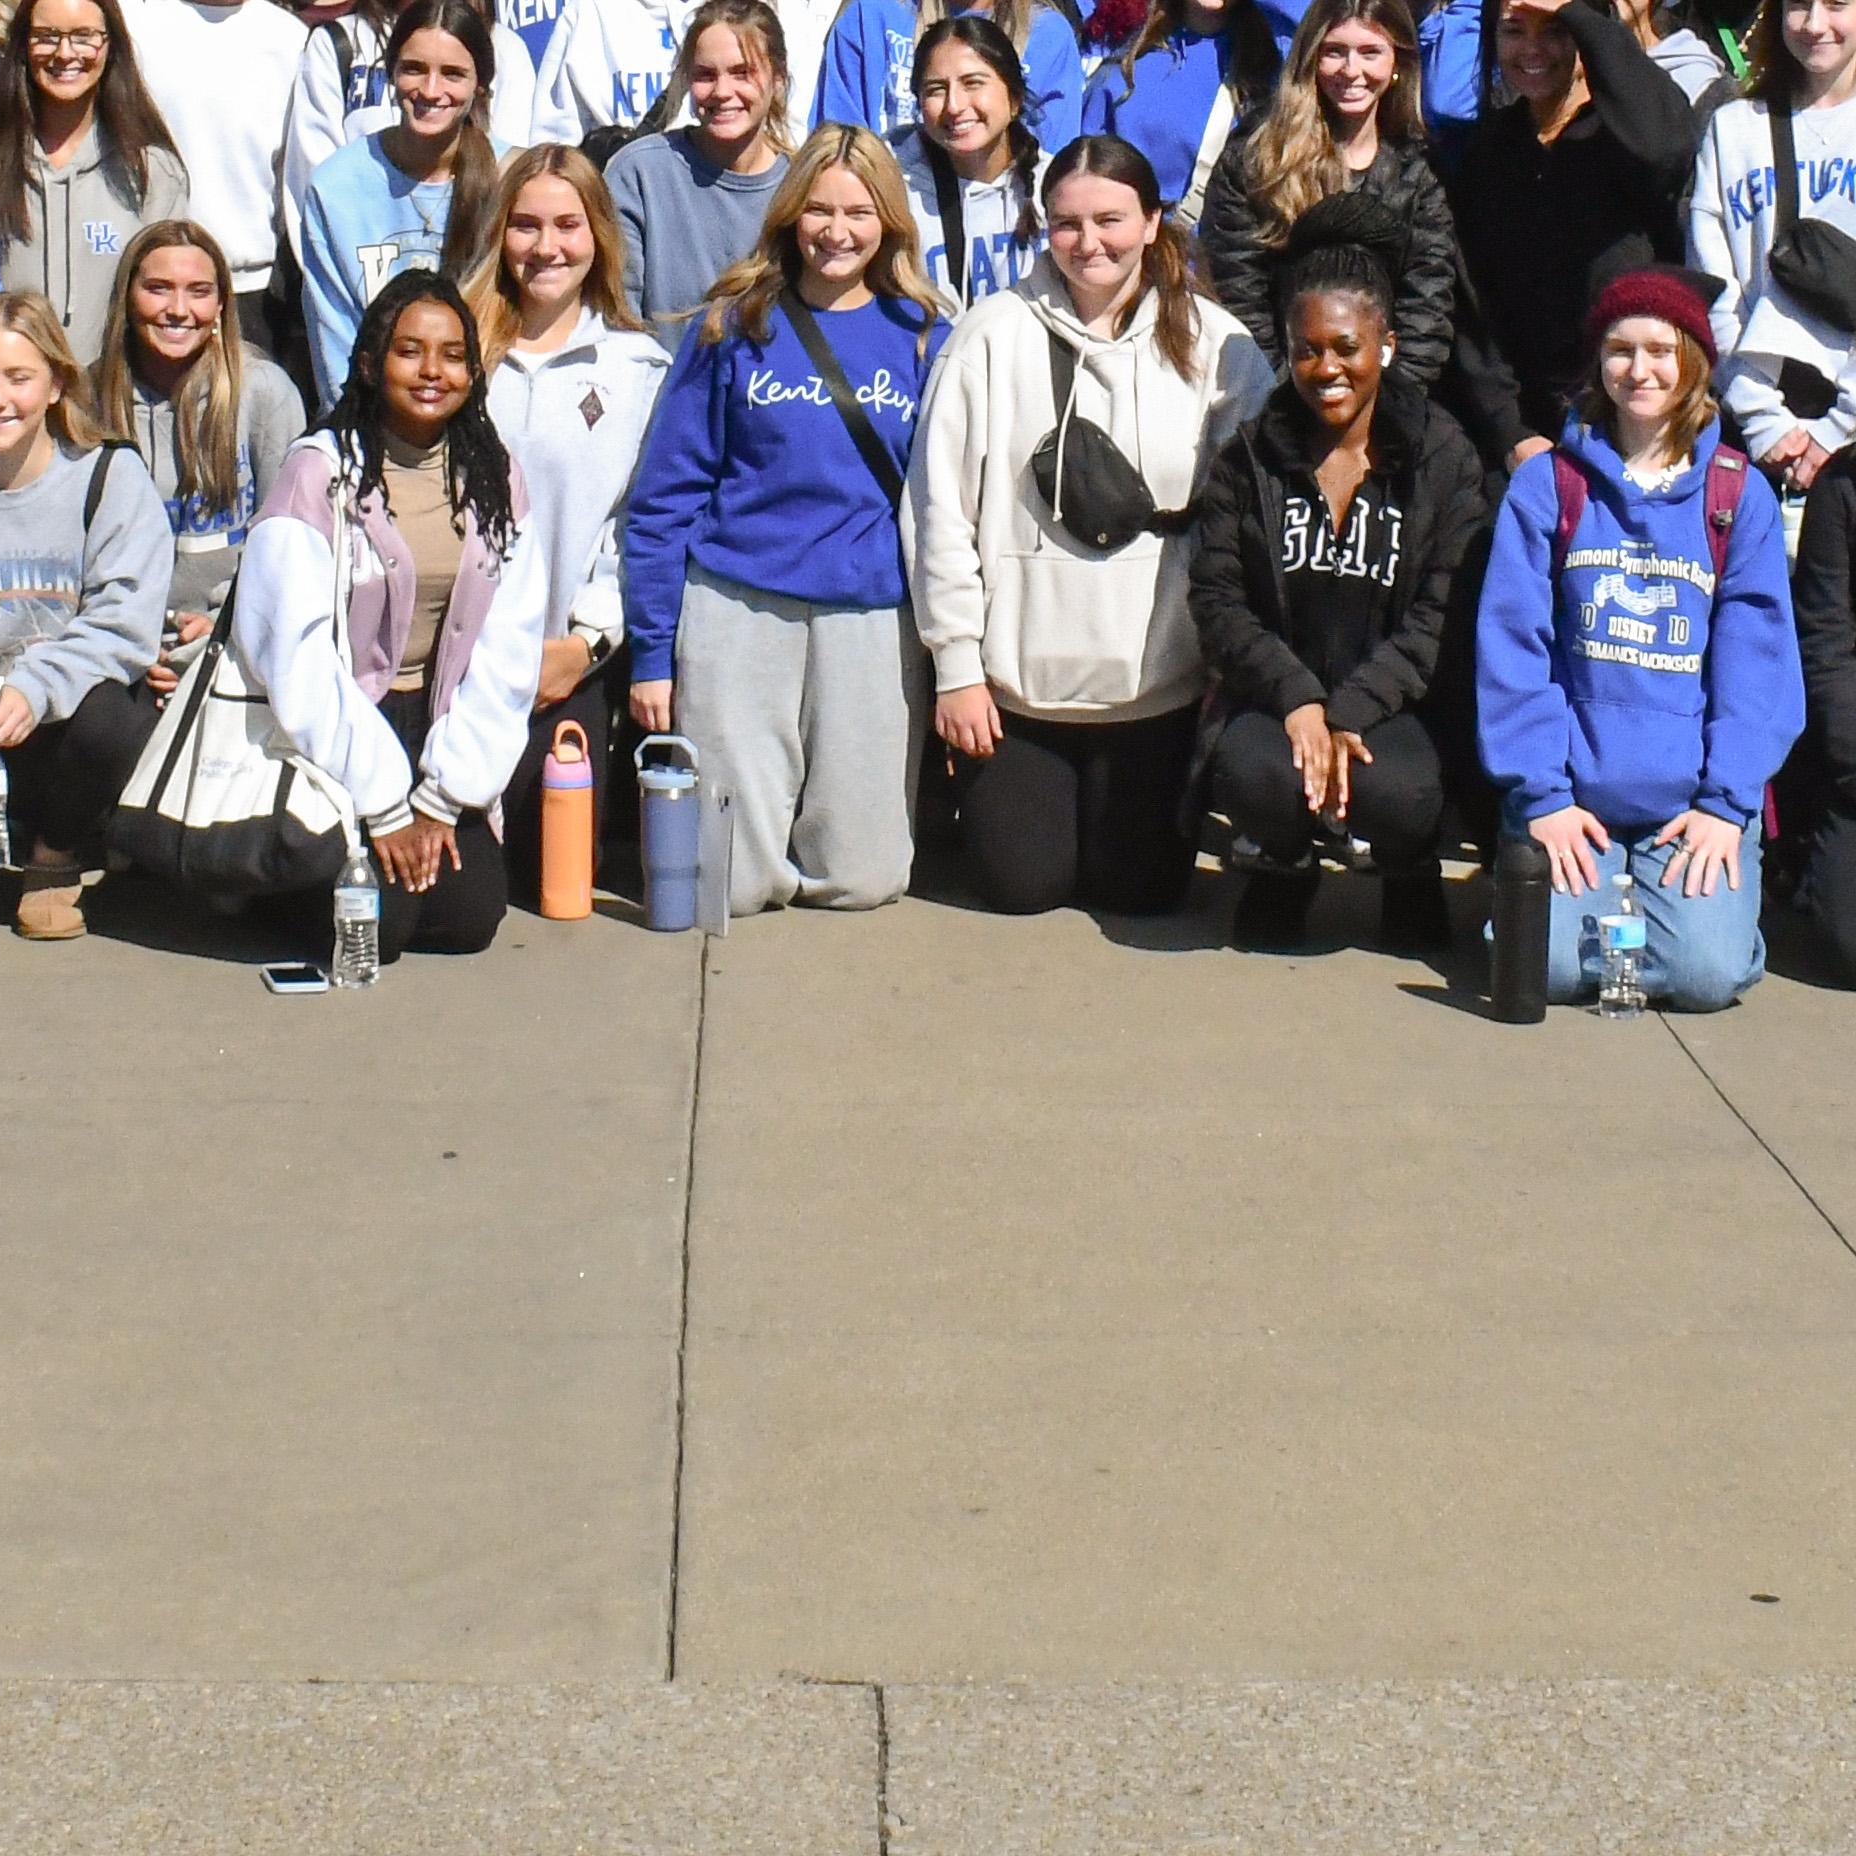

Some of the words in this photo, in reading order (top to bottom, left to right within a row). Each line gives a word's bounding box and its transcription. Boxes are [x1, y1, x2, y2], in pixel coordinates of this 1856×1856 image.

[83, 222, 119, 253] UK
[746, 368, 915, 423] Kentcky
[1619, 548, 1691, 580] Symphonic
[1667, 614, 1691, 645] 10
